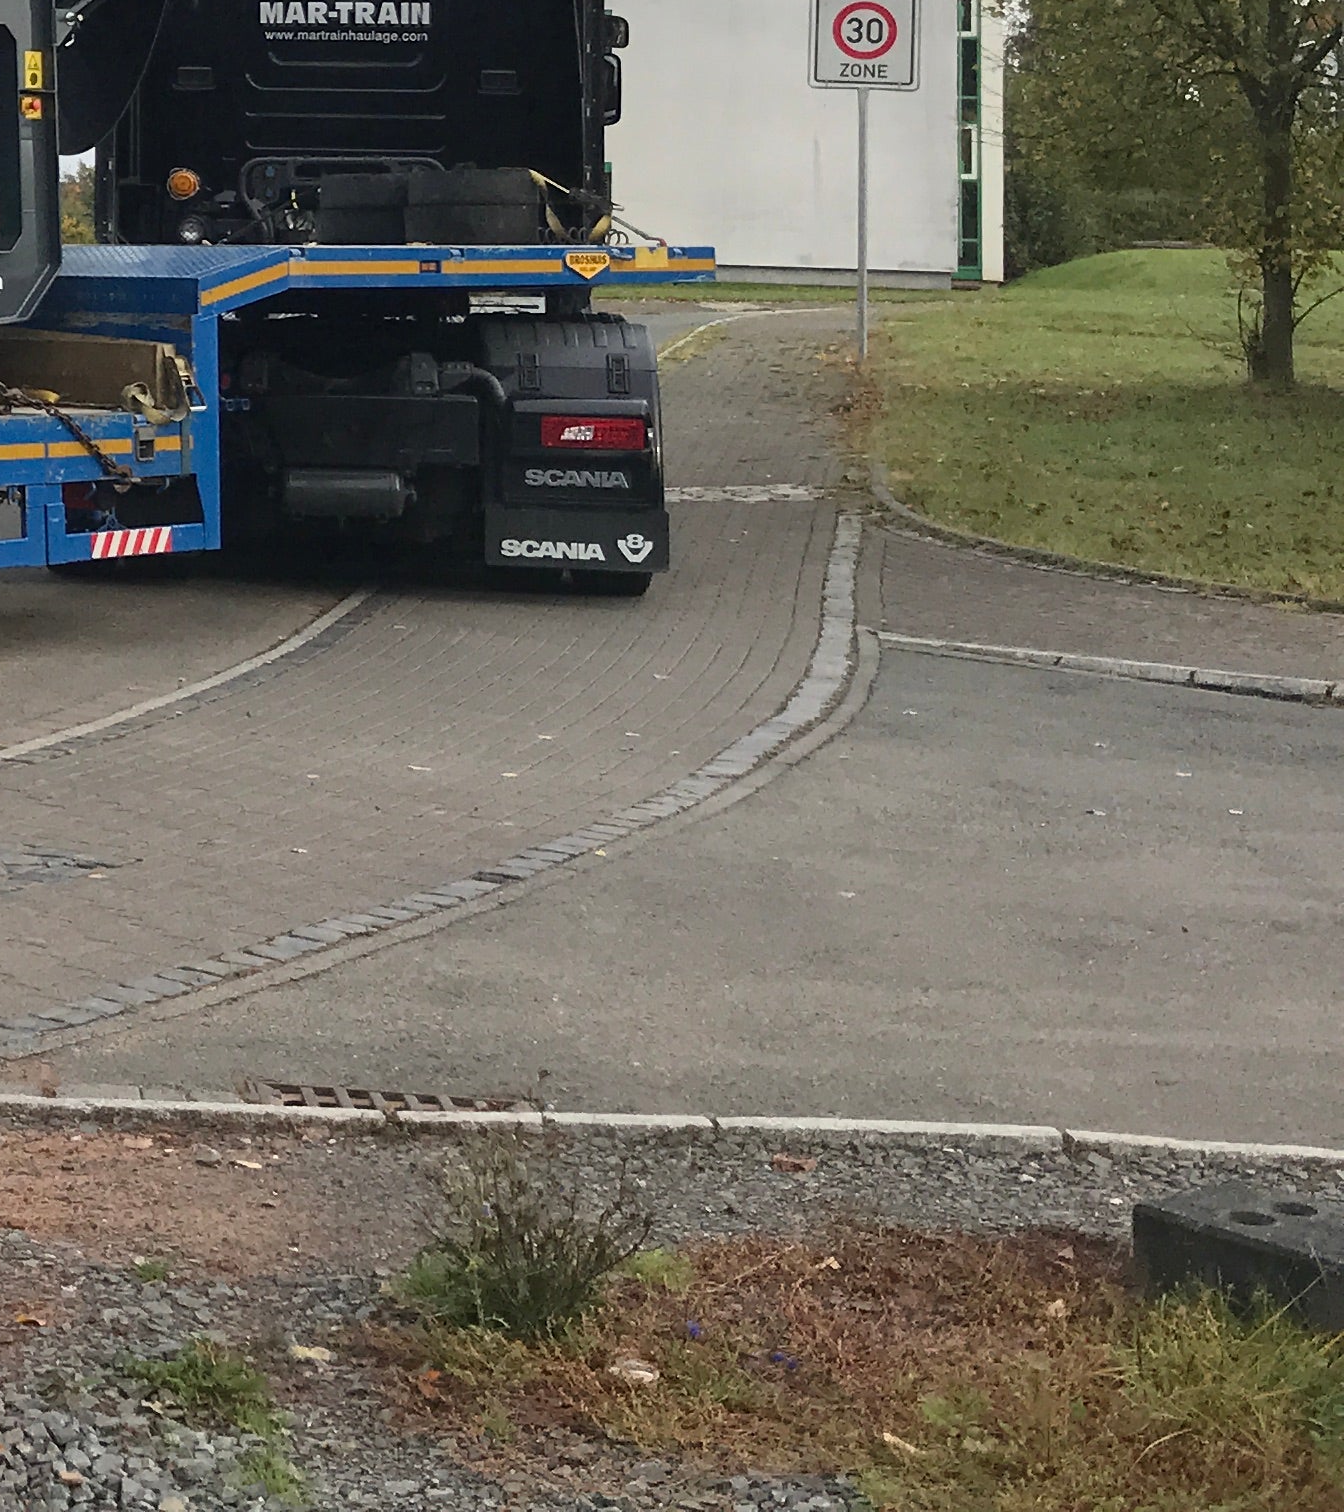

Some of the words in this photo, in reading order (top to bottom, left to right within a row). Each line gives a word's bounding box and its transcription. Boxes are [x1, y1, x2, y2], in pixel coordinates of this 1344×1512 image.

[259, 1, 431, 26] MAR-TRAIN
[264, 29, 429, 44] www.martrainhaulage.com
[846, 17, 884, 44] 30
[839, 62, 889, 79] ZONE
[524, 468, 630, 489] SCANIA
[500, 538, 606, 562] SCANIA
